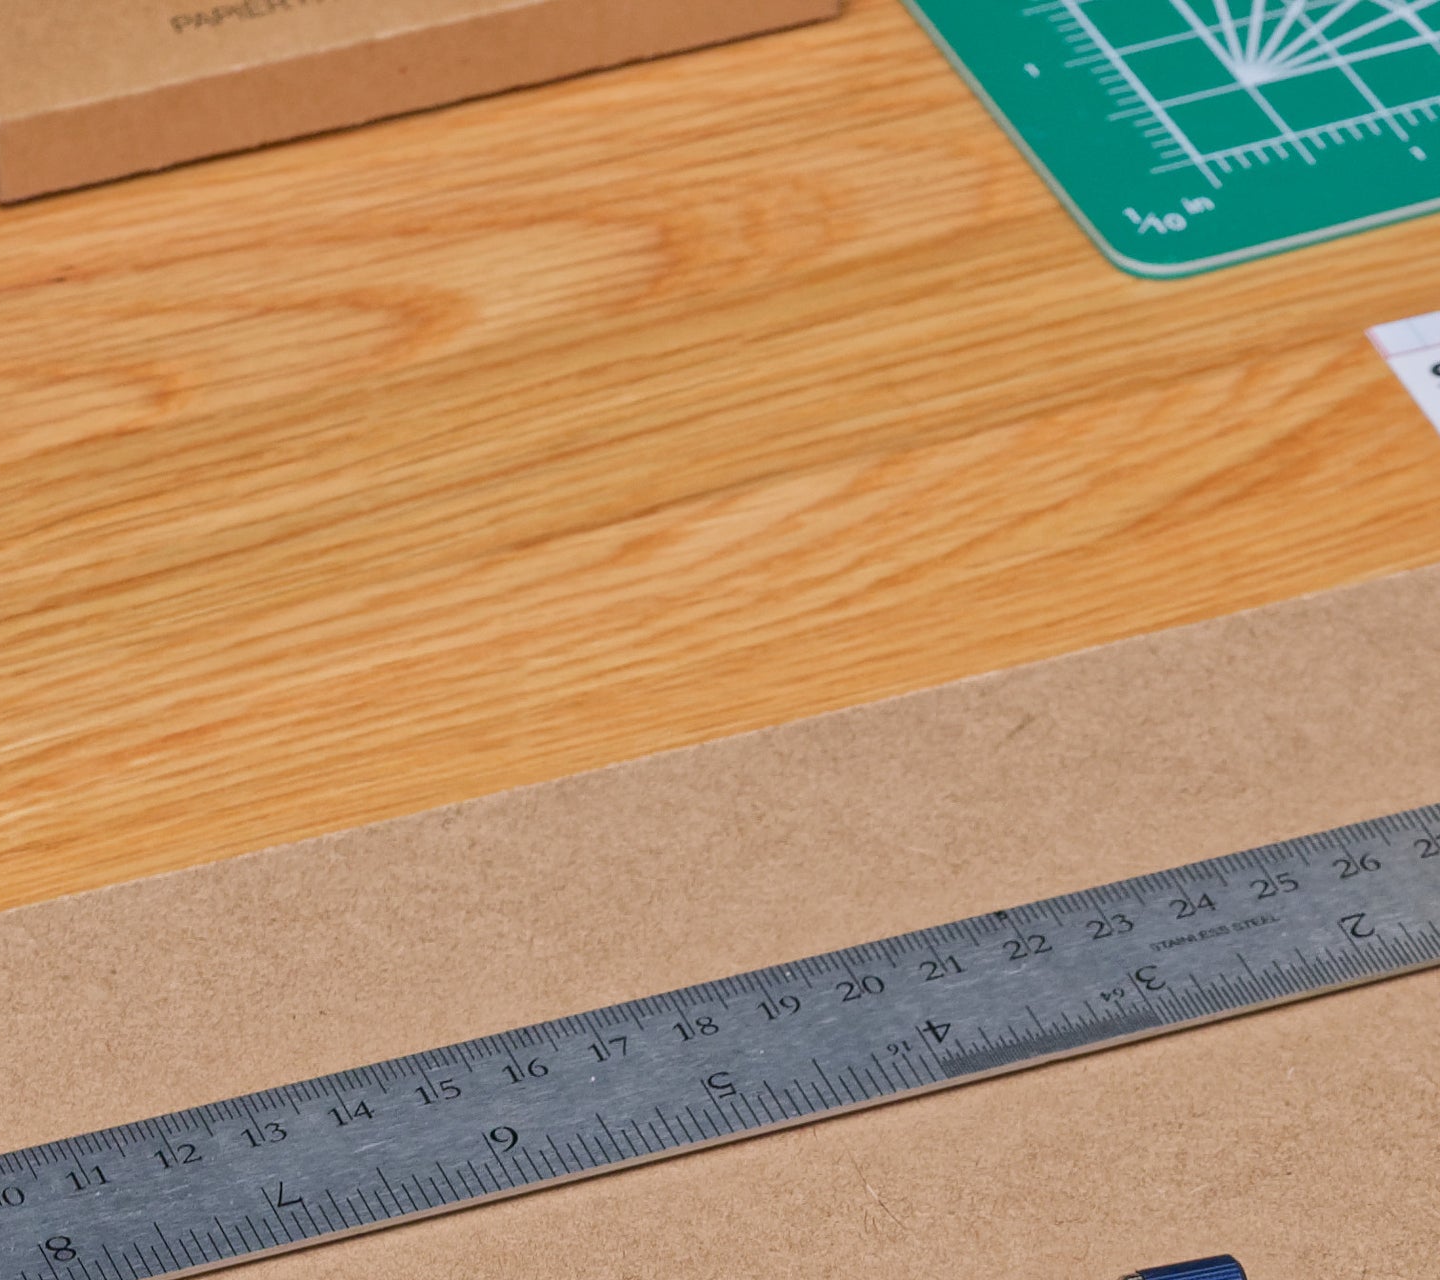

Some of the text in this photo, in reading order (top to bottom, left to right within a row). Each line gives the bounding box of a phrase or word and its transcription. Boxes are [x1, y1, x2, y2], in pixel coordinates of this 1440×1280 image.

[1150, 914, 1281, 951] STAINLESS STEEL
[1343, 912, 1376, 940] 2
[1136, 965, 1167, 993] 3
[65, 1164, 111, 1192] 11
[154, 1142, 203, 1171] 12
[240, 1121, 289, 1149] 13
[326, 1099, 376, 1128] 14
[414, 1079, 462, 1106] 15
[500, 1056, 550, 1084] 16
[586, 1035, 631, 1062] 17
[671, 1014, 720, 1043] 18
[756, 994, 802, 1022] 19
[836, 973, 886, 1002] 20
[918, 954, 964, 982] 21
[1001, 934, 1053, 961] 22
[1086, 912, 1136, 941] 23
[1168, 891, 1216, 921] 24
[1249, 871, 1300, 900] 25
[1331, 851, 1382, 880] 26
[922, 1018, 953, 1044] 4
[707, 1071, 737, 1098] 5
[489, 1125, 519, 1152] 6
[274, 1181, 303, 1209] 7
[44, 1234, 78, 1262] 8
